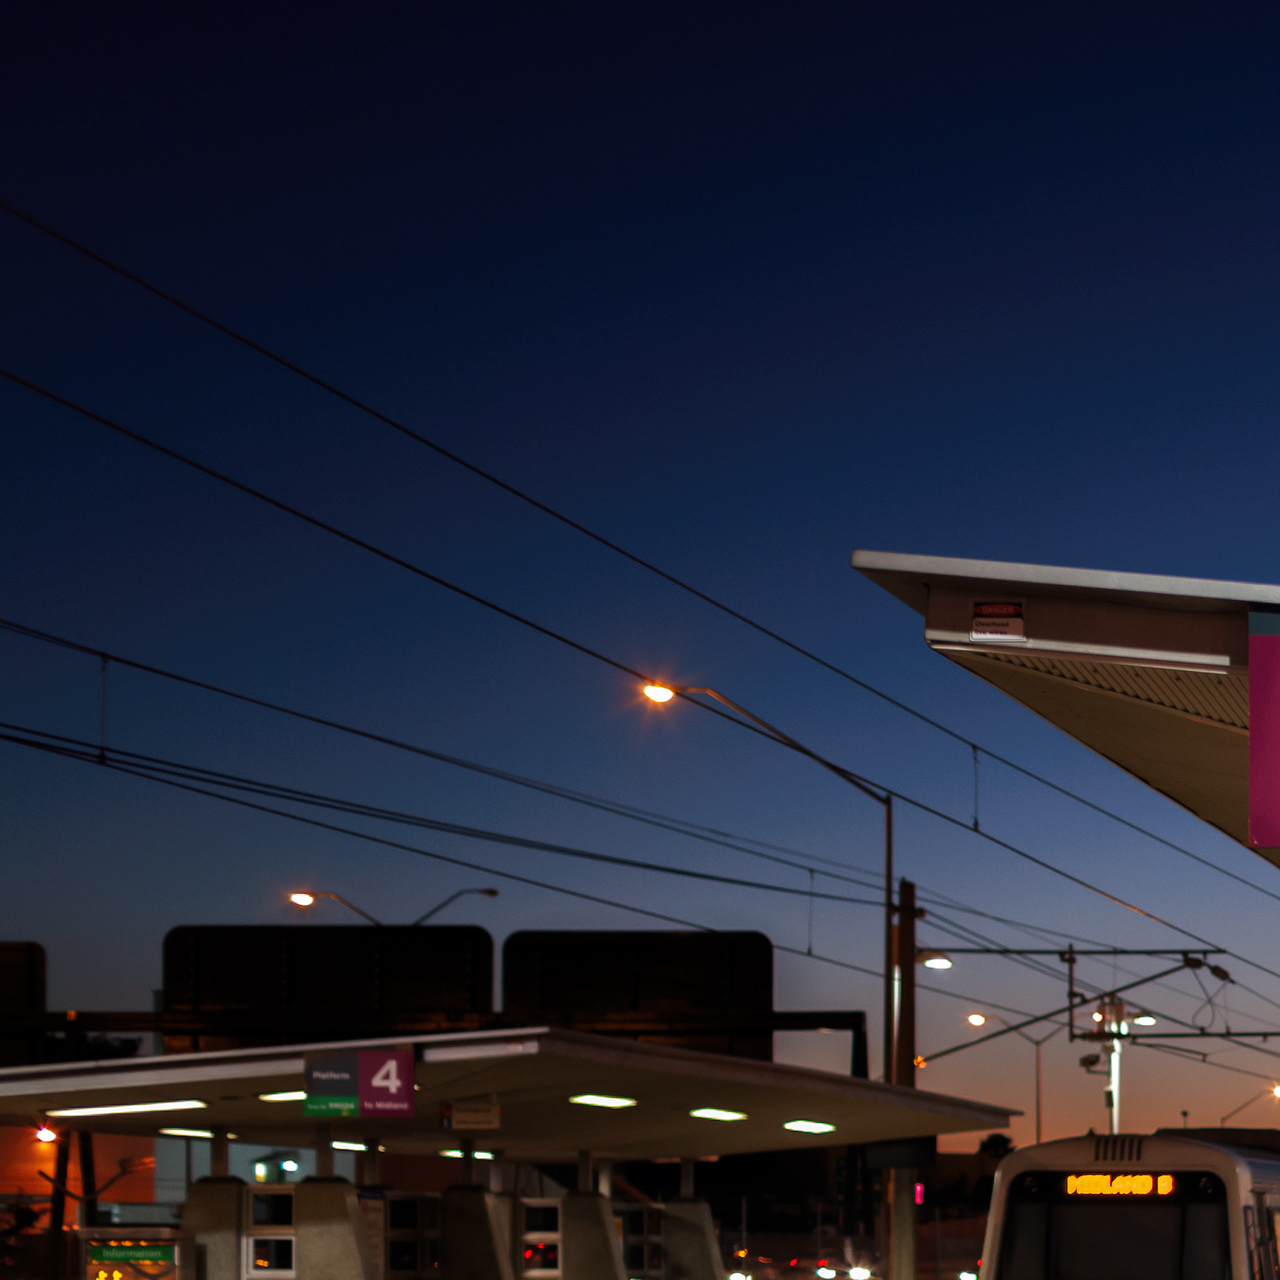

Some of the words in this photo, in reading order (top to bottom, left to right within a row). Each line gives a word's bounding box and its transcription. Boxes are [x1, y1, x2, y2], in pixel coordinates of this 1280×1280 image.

[312, 1070, 350, 1080] Platform
[370, 1059, 402, 1095] 4
[1066, 1174, 1154, 1195] MIDLAND
[102, 1248, 163, 1259] Information
